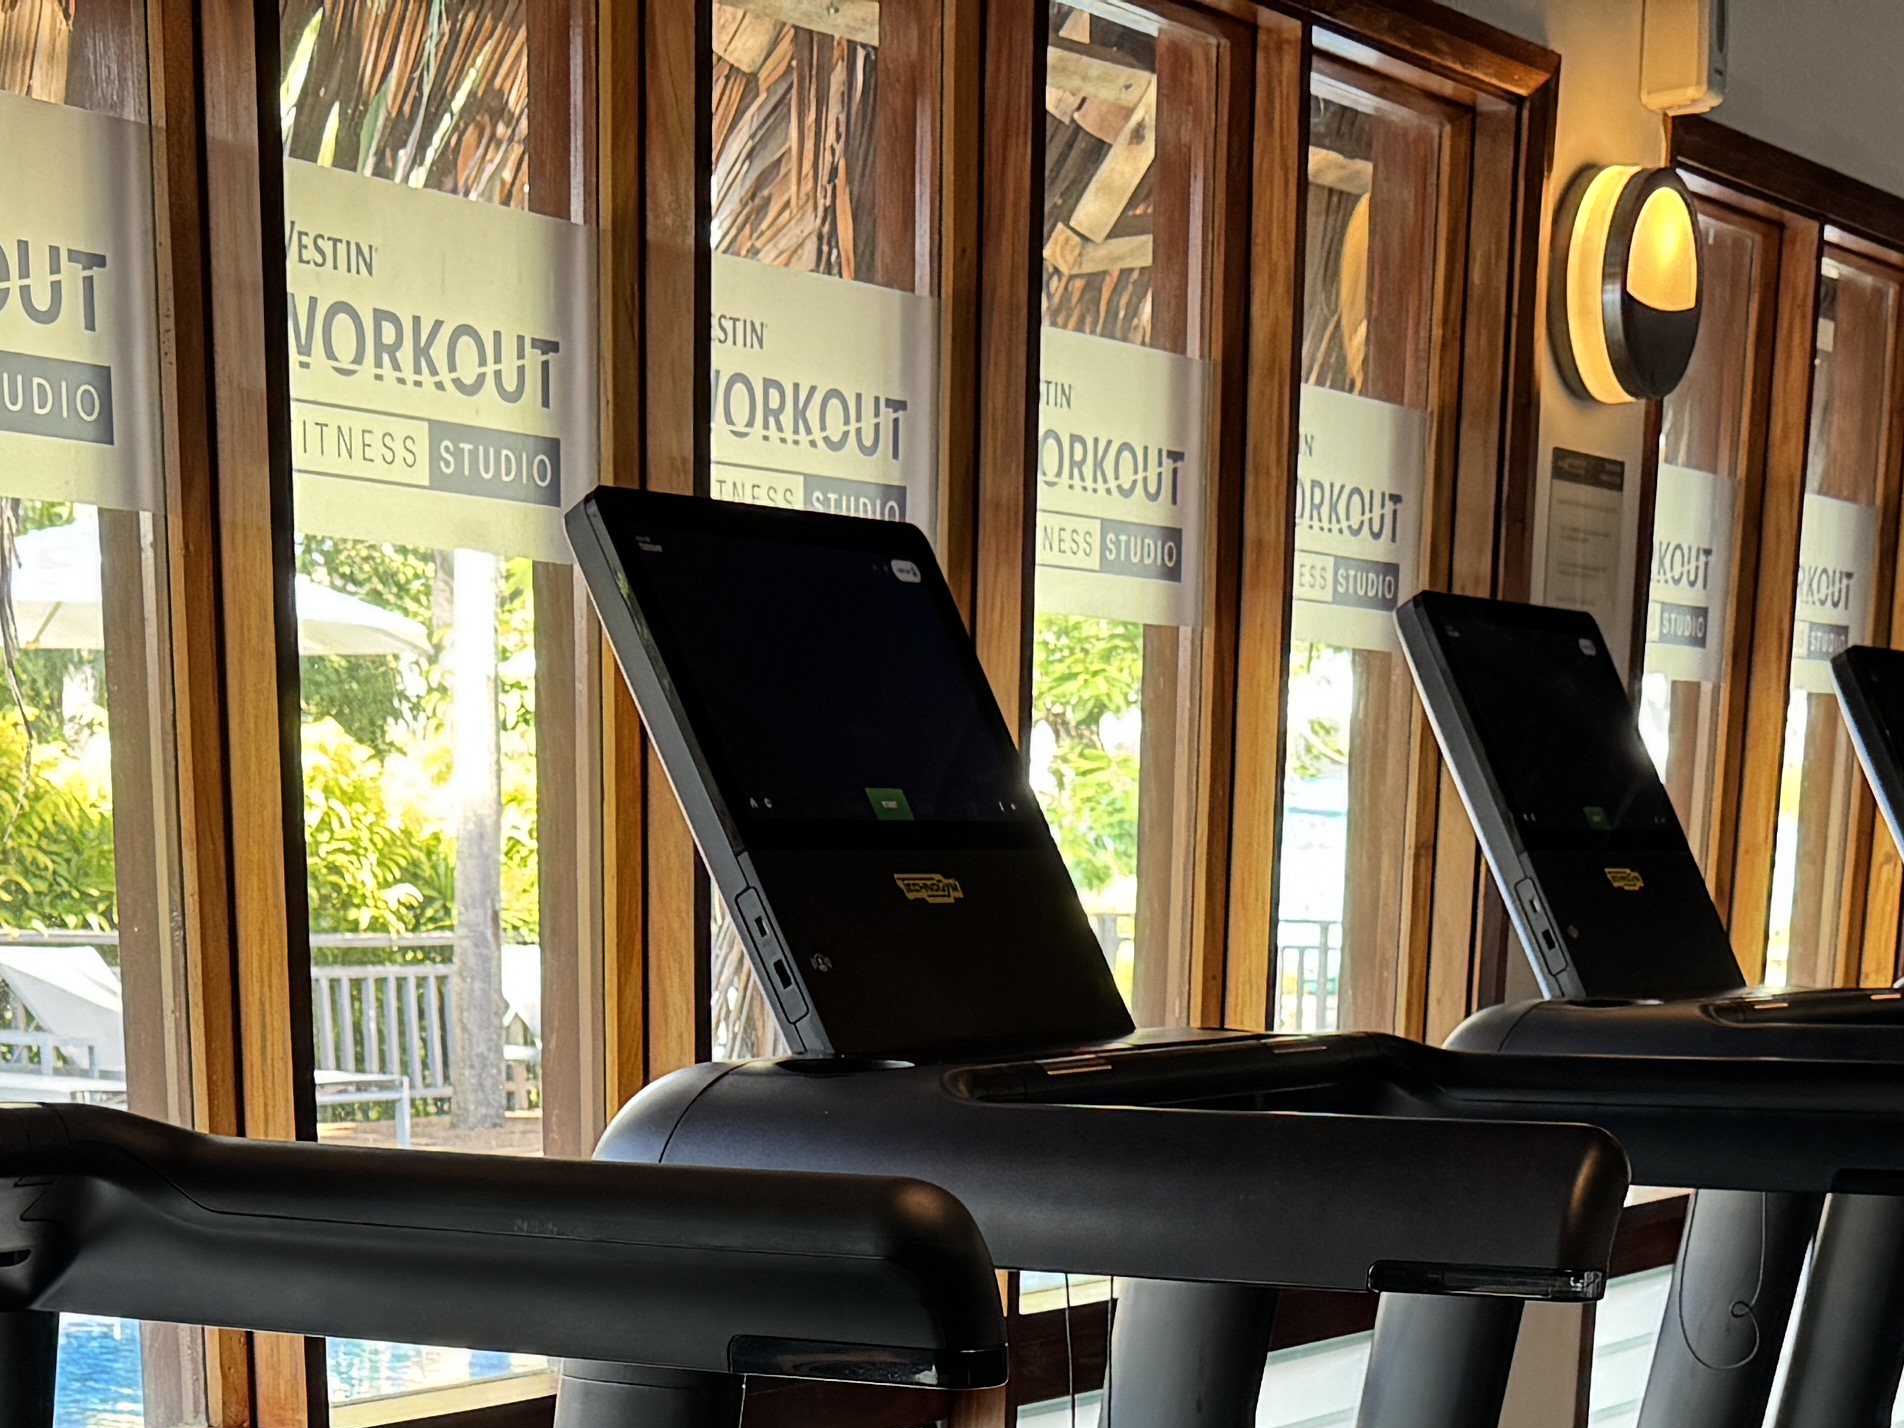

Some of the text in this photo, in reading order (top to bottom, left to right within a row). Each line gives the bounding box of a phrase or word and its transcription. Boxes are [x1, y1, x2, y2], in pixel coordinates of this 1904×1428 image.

[287, 220, 373, 277] ESTIN
[713, 314, 764, 350] STIN
[711, 369, 907, 460] ORKOUT
[1044, 380, 1071, 409] TIN
[302, 420, 552, 488] ITNESS STUDIO
[1039, 429, 1185, 506] ORKOUT
[716, 480, 900, 522] TNESS STUDIO
[1043, 524, 1177, 567] NESS STUDIO
[1657, 541, 1712, 590] KOUT
[1336, 565, 1394, 599] STUDIO
[1662, 617, 1704, 638] STUDIO
